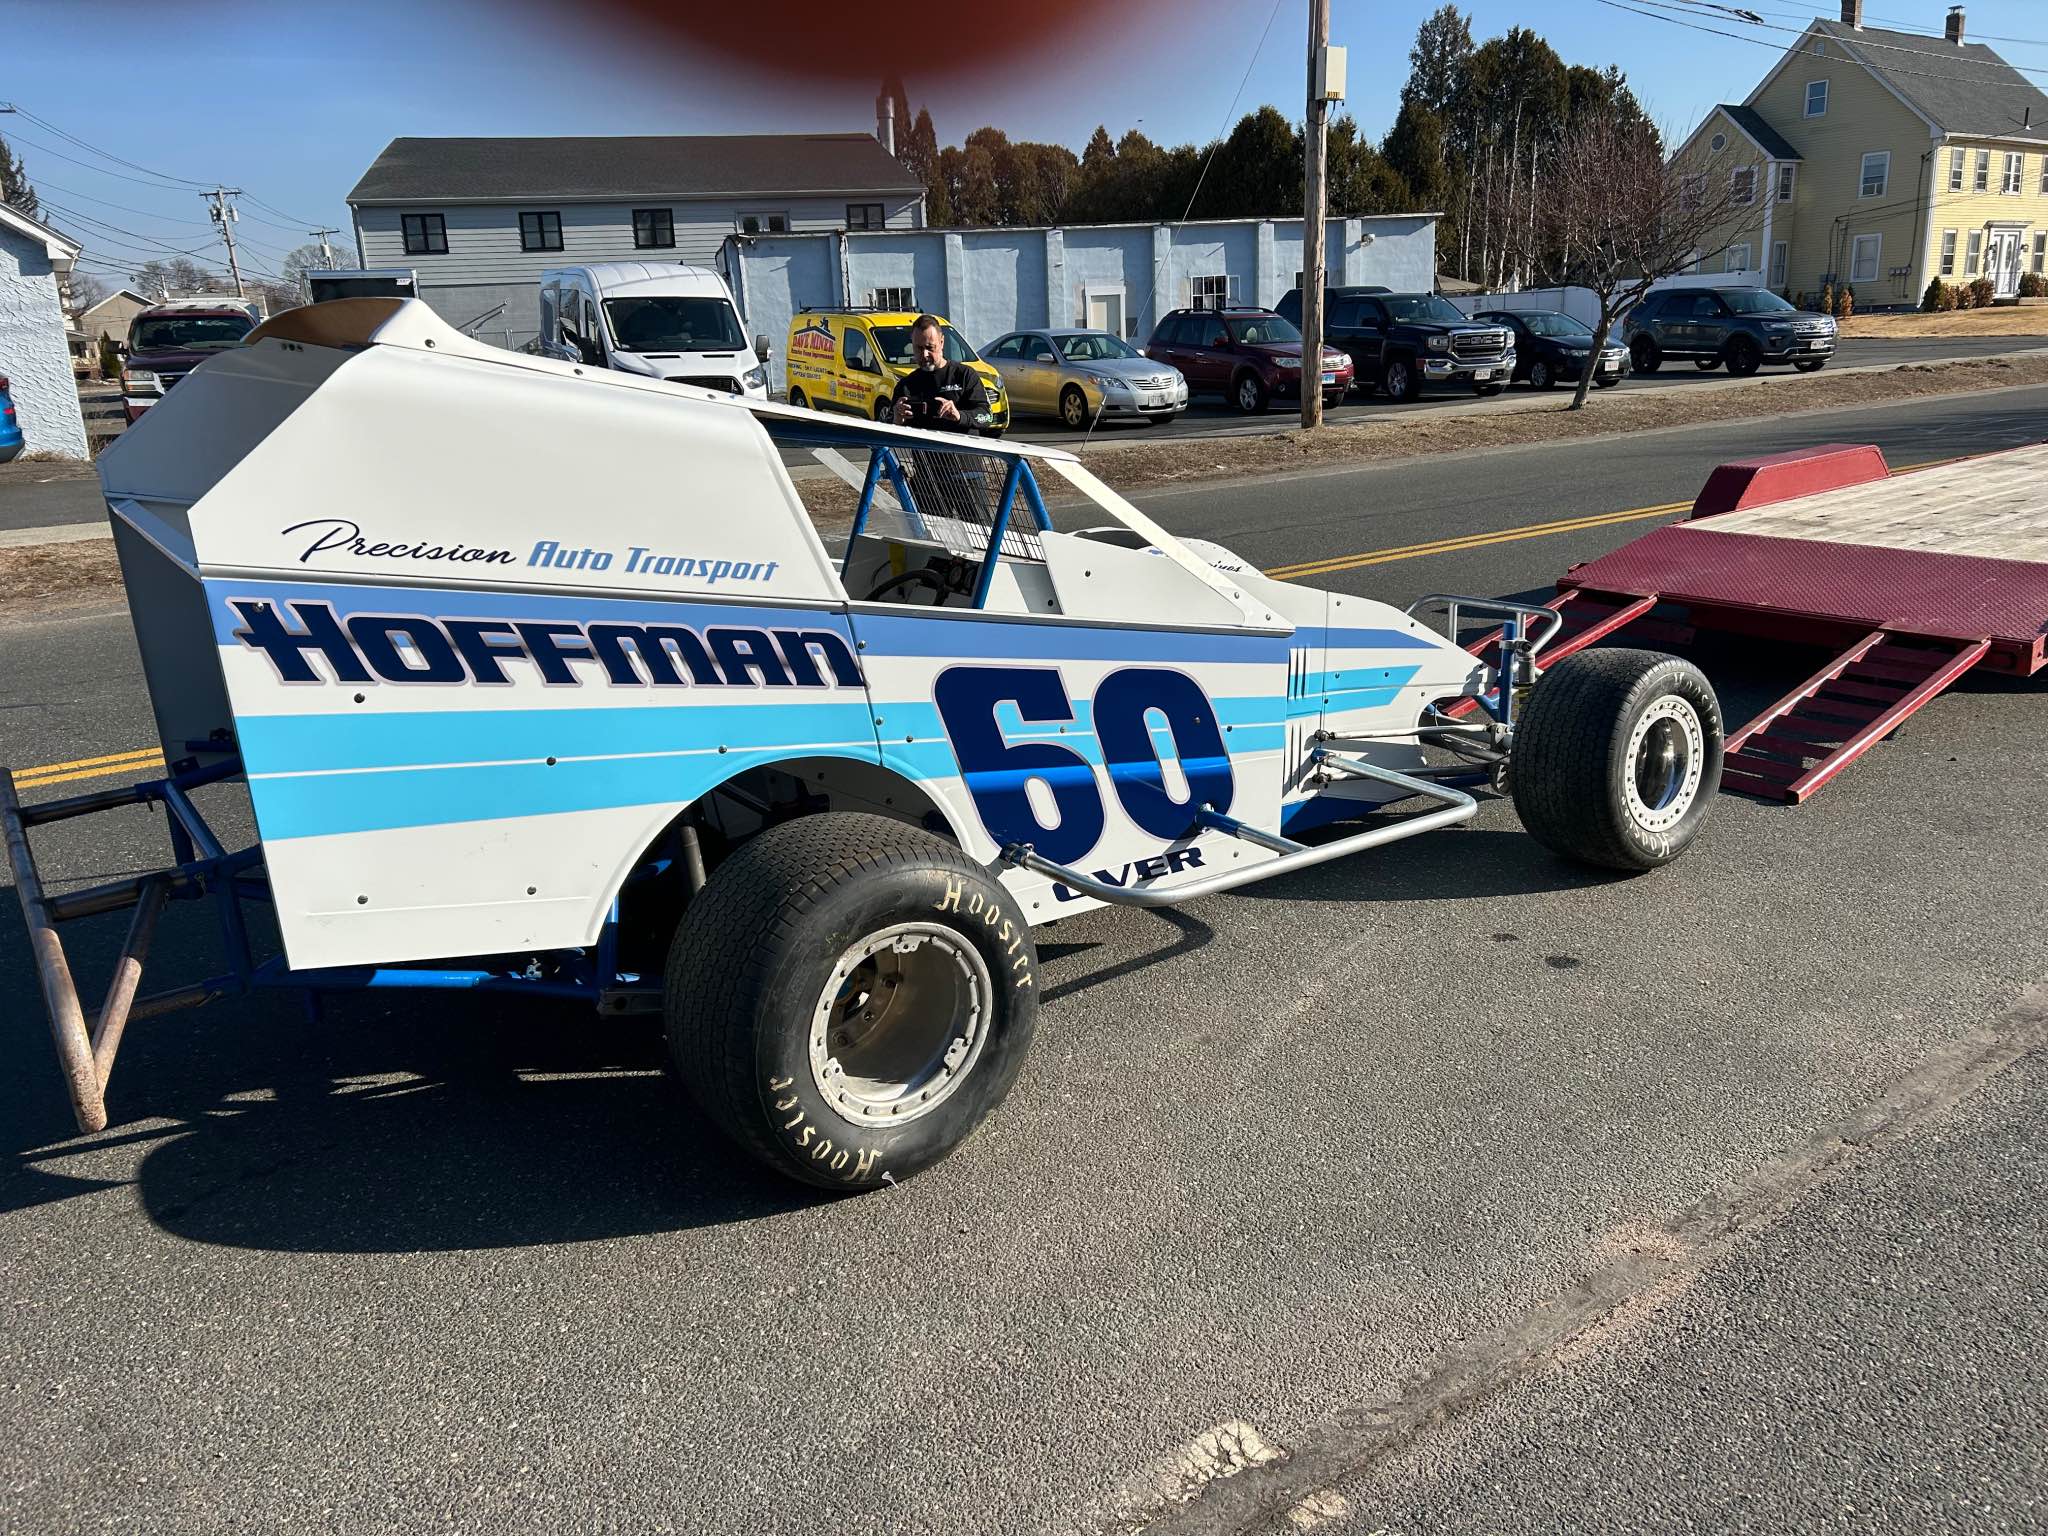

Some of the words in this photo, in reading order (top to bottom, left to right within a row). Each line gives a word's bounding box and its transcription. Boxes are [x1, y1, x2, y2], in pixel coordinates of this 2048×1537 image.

[793, 332, 809, 349] DAVE
[810, 332, 834, 352] MINER
[1471, 336, 1492, 344] GMC
[281, 518, 516, 564] Precision
[526, 541, 612, 573] Auto
[625, 547, 779, 584] Transport
[225, 596, 869, 690] HOFFMAN
[931, 663, 1237, 868] 60
